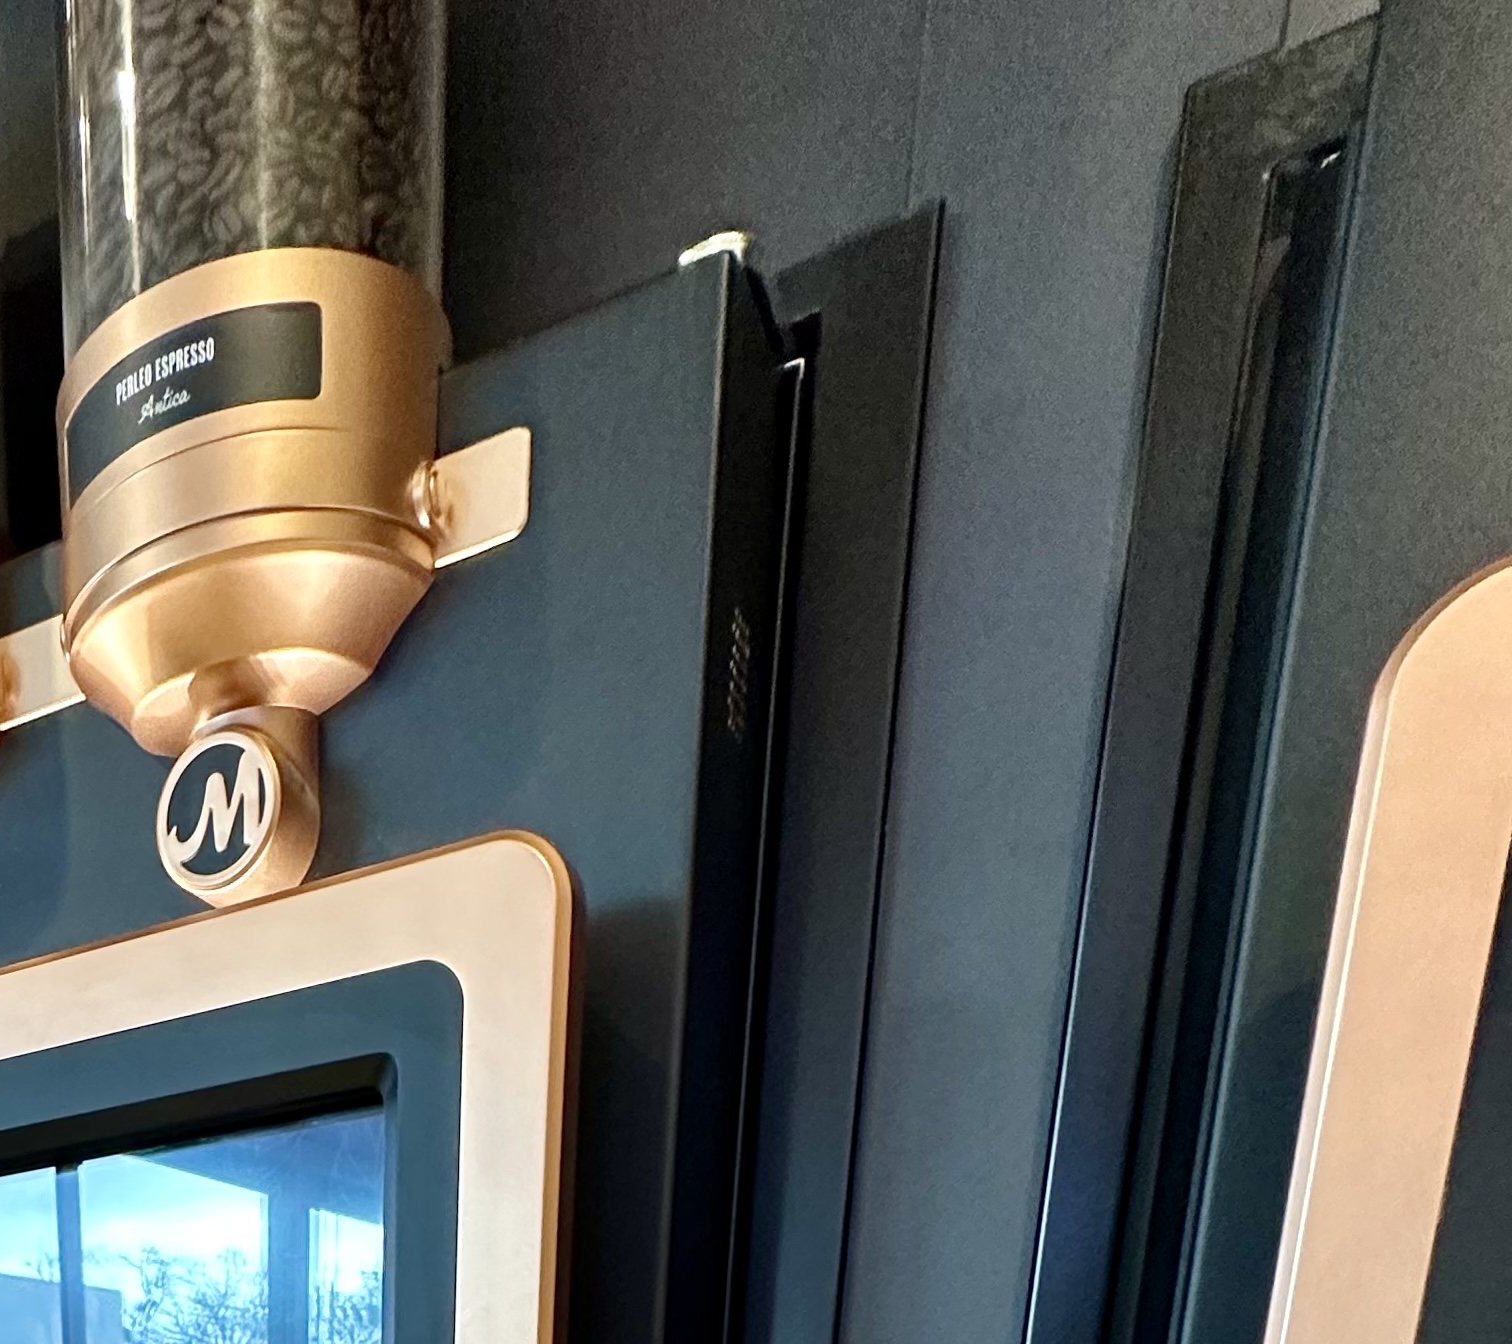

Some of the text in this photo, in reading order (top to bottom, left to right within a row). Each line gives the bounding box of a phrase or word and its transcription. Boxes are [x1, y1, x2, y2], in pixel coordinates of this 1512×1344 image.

[115, 337, 216, 406] PERLEO ESPRESSO
[138, 385, 191, 425] Antica
